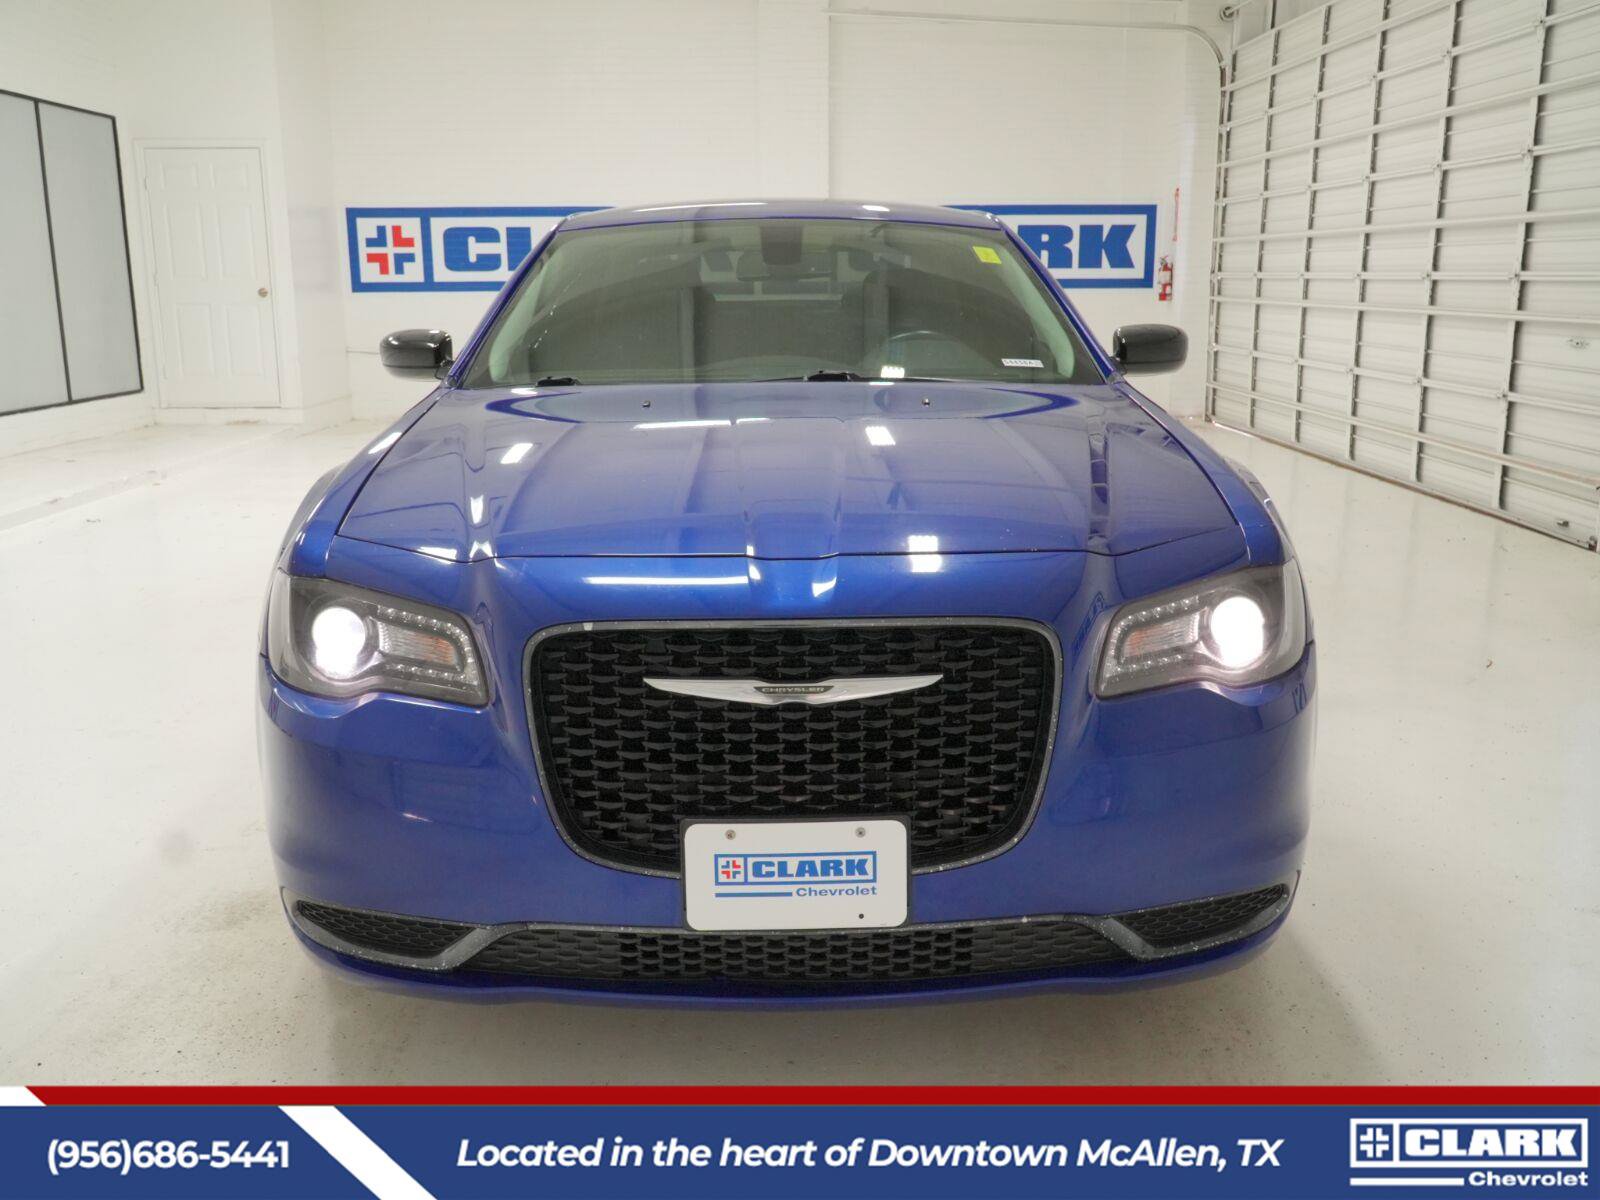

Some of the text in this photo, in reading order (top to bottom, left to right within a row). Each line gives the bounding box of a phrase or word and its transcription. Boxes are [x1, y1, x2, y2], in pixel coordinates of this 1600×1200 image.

[761, 686, 825, 694] CHRYSLER
[752, 858, 869, 878] CLARK
[796, 886, 878, 897] Chevrolet
